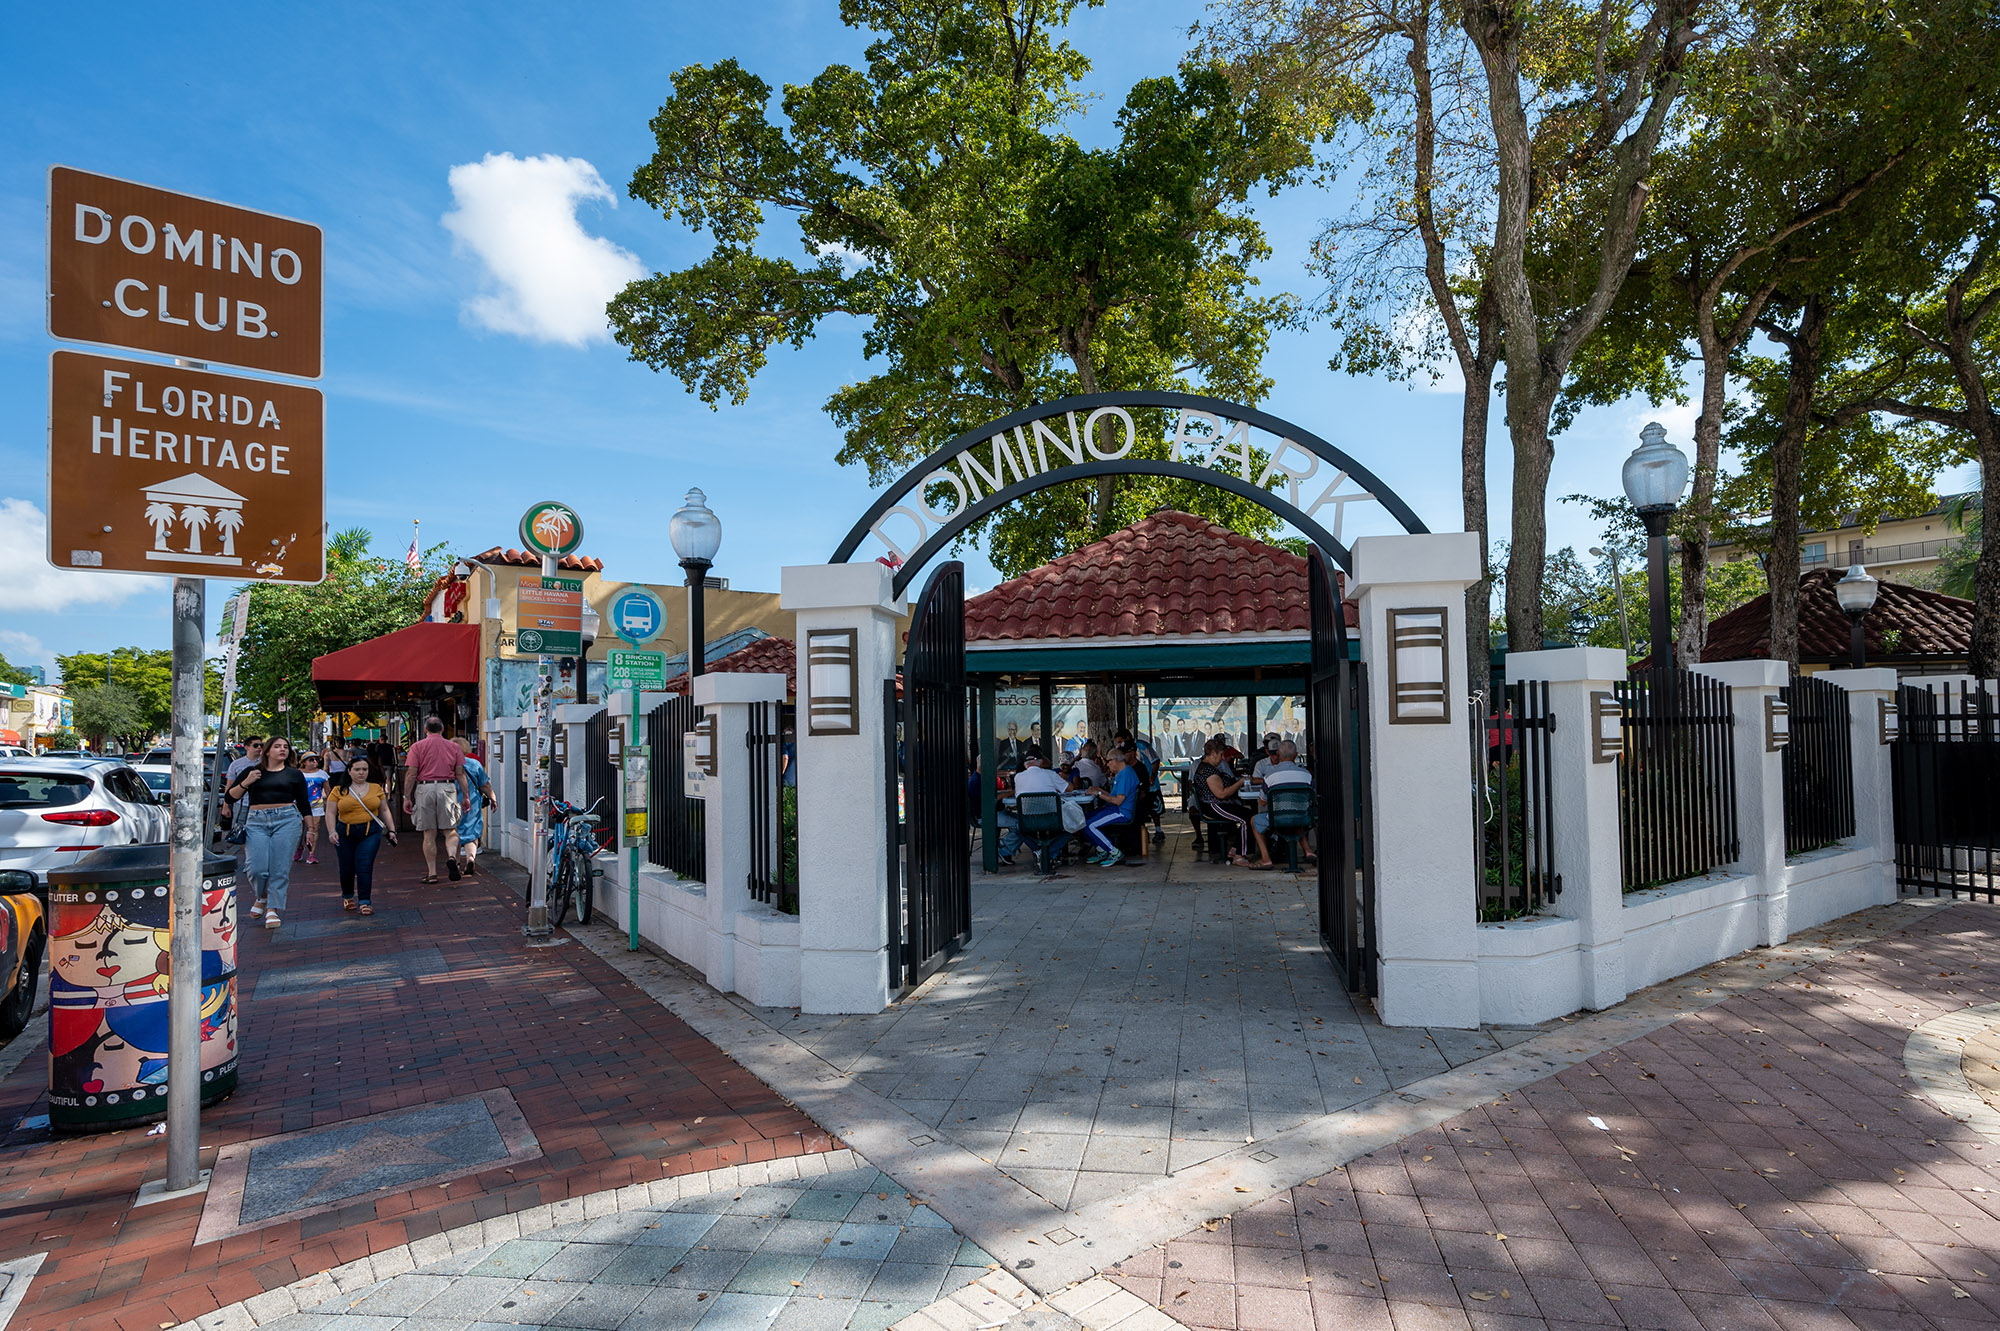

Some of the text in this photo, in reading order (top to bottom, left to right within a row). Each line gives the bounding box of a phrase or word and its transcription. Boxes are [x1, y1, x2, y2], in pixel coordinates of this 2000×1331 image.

[75, 203, 302, 285] DOMINO
[114, 278, 268, 339] CLUB
[104, 370, 280, 430] FLORIDA
[92, 416, 290, 475] HERITAGE
[869, 406, 1378, 561] DOMINO PARK
[520, 580, 581, 591] Miami TROLLEY
[501, 638, 516, 647] AR
[615, 653, 623, 665] 8
[613, 667, 630, 678] 208
[217, 876, 233, 887] KEEP
[53, 893, 79, 902] LITTER
